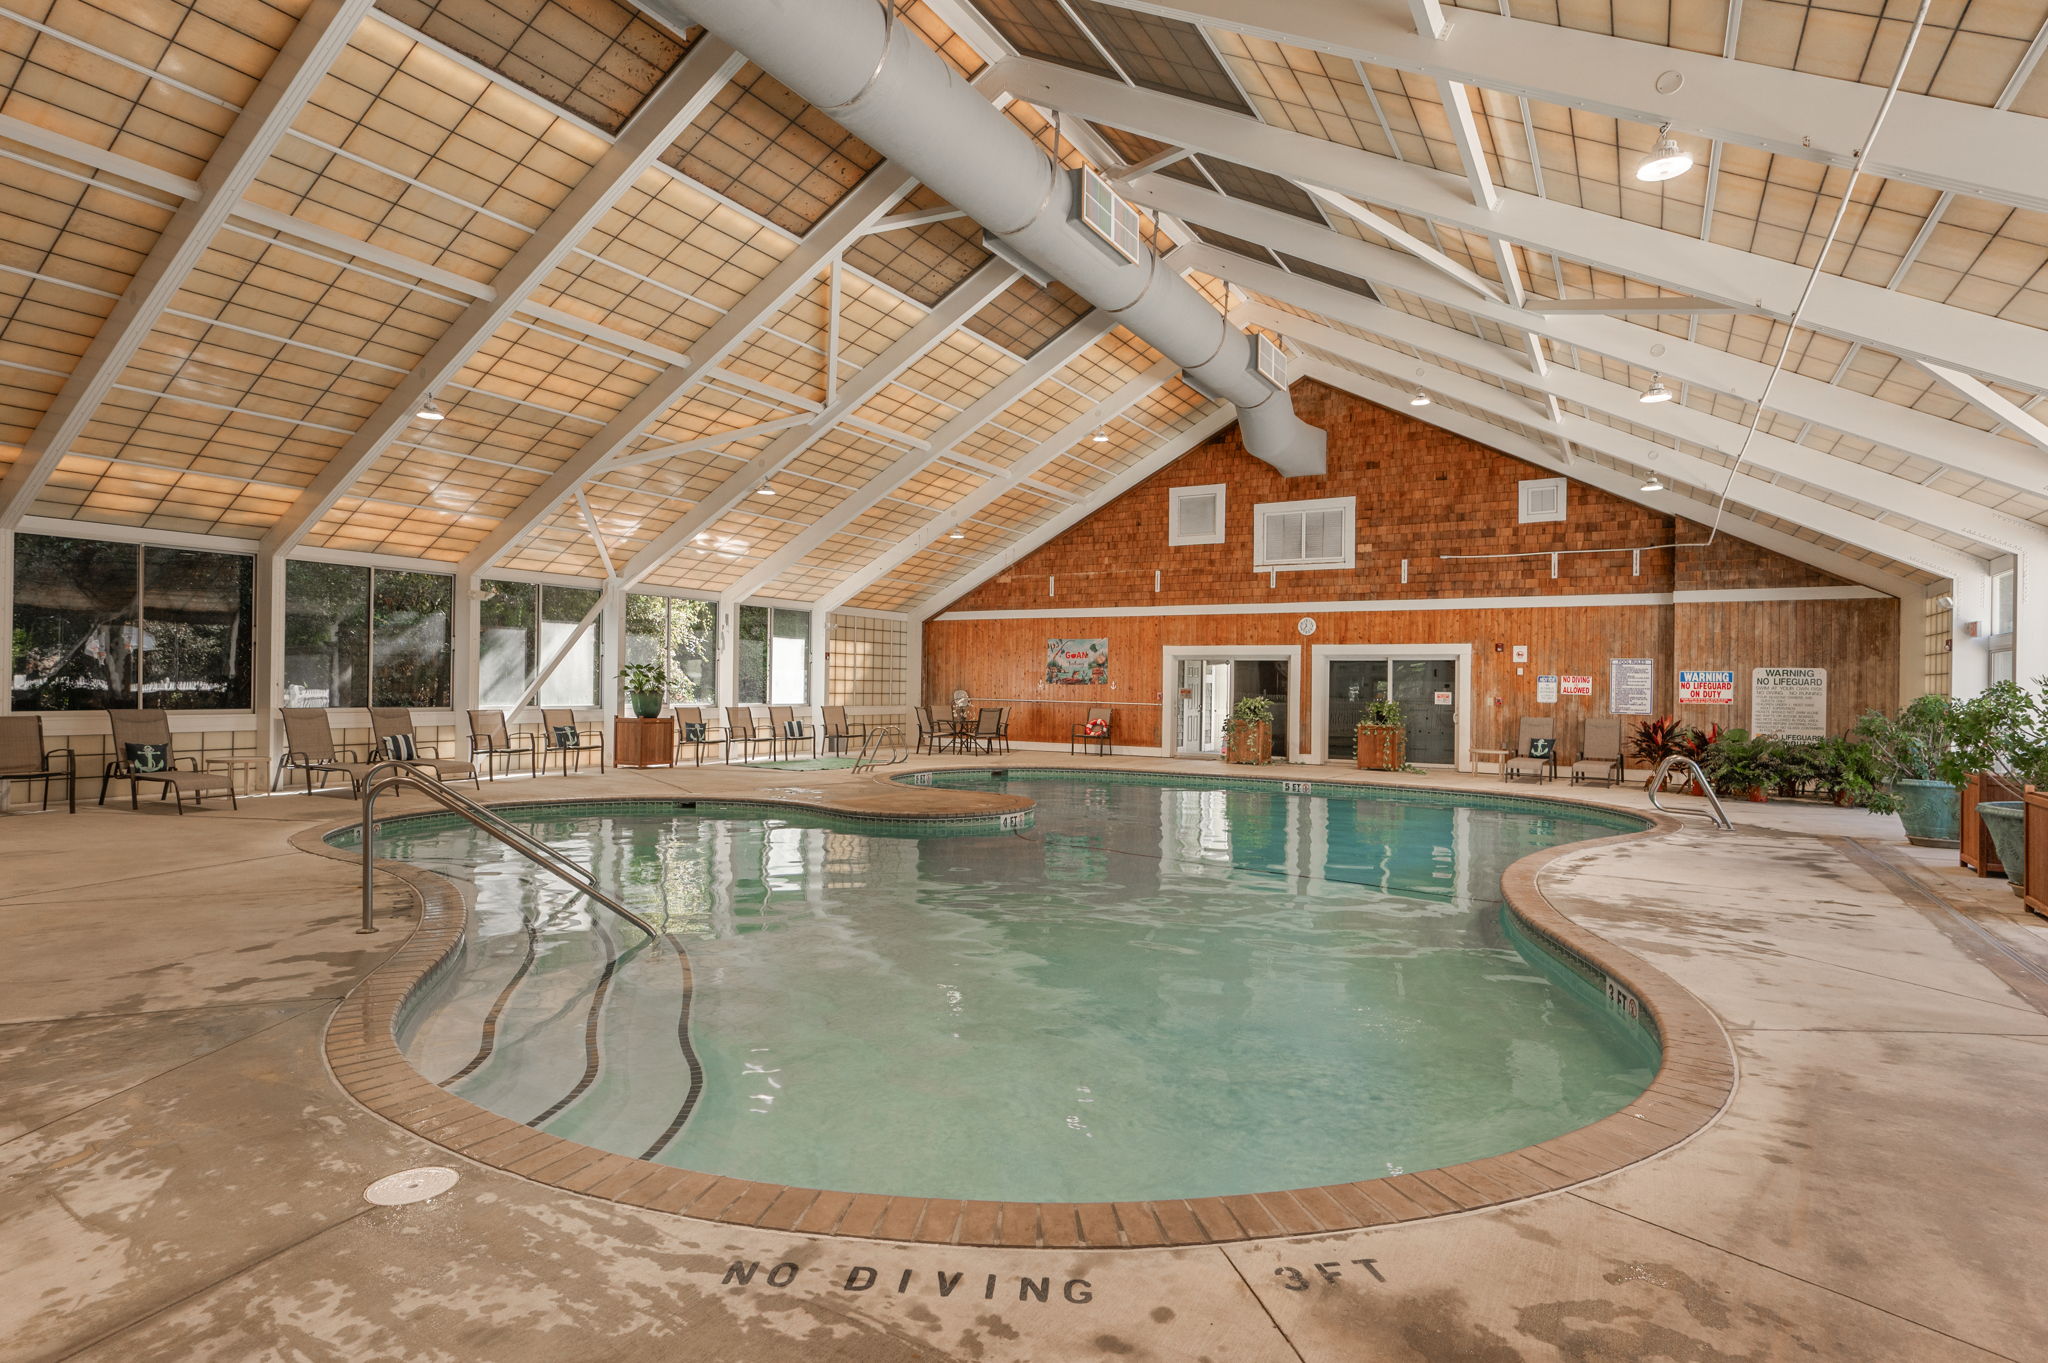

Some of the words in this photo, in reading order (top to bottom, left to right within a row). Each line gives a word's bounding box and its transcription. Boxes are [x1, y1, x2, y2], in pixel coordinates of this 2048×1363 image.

[1572, 676, 1590, 684] DIVING
[1684, 672, 1730, 682] WARNING
[1680, 682, 1691, 690] NO
[1693, 682, 1732, 690] LIFEGUARD
[1756, 678, 1770, 686] NO
[1773, 678, 1823, 686] LIFEGUARD
[1563, 686, 1590, 694] ALLOWED
[1690, 690, 1700, 698] ON
[1703, 690, 1721, 698] DUTY
[1608, 983, 1615, 1001] 3
[1617, 989, 1627, 1011] FT
[721, 1260, 799, 1288] NO
[843, 1265, 1093, 1304] DIVING
